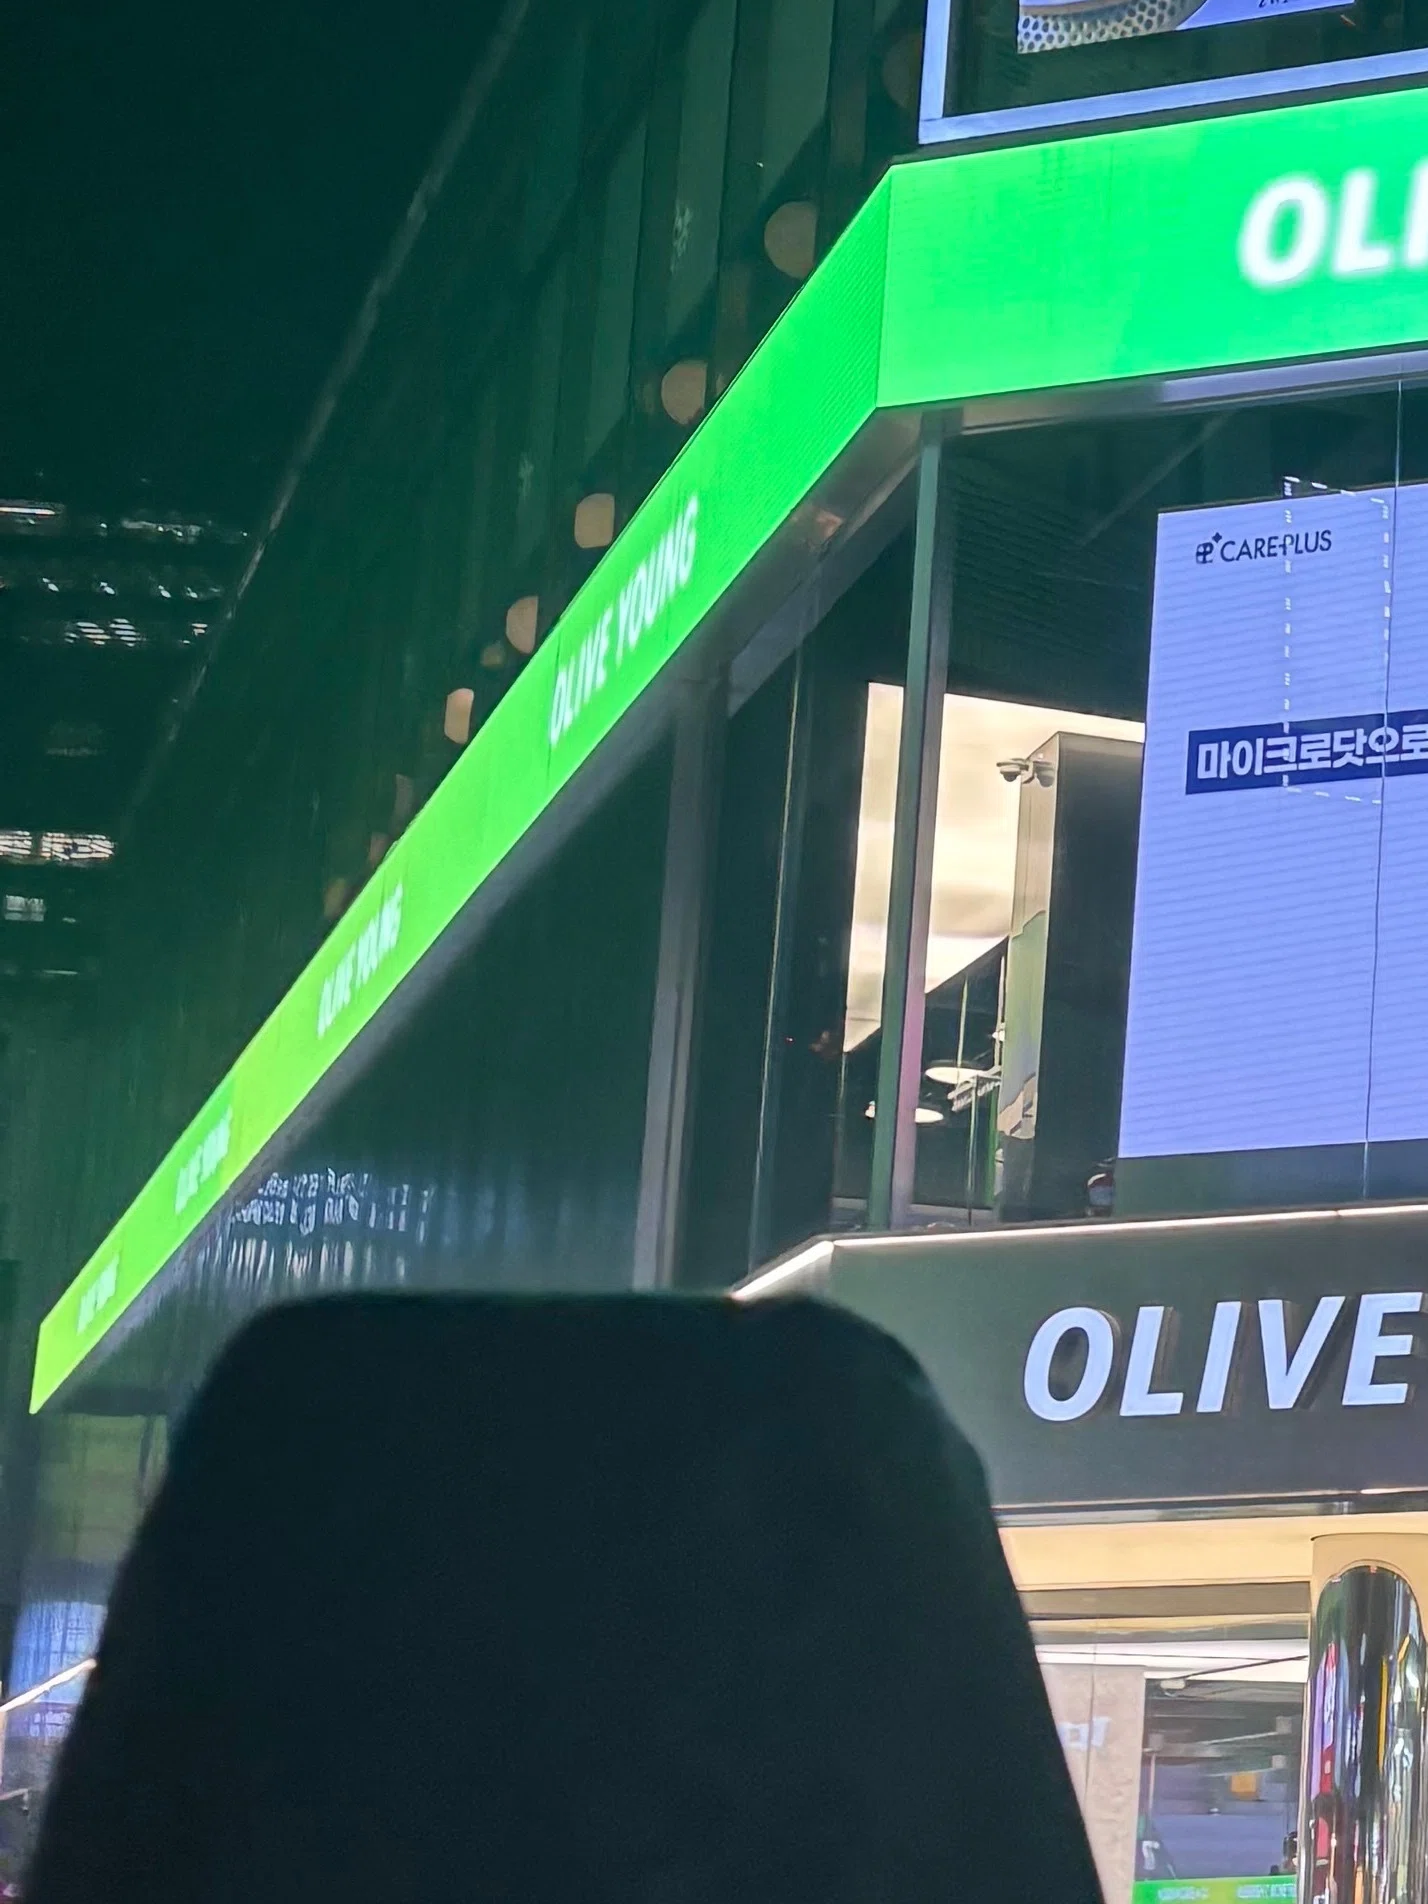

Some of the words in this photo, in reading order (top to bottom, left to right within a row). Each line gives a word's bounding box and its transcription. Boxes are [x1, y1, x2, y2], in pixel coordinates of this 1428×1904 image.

[548, 602, 614, 748] OLIVE
[615, 494, 698, 671] YOUNG
[1023, 1289, 1427, 1424] OLIVE
